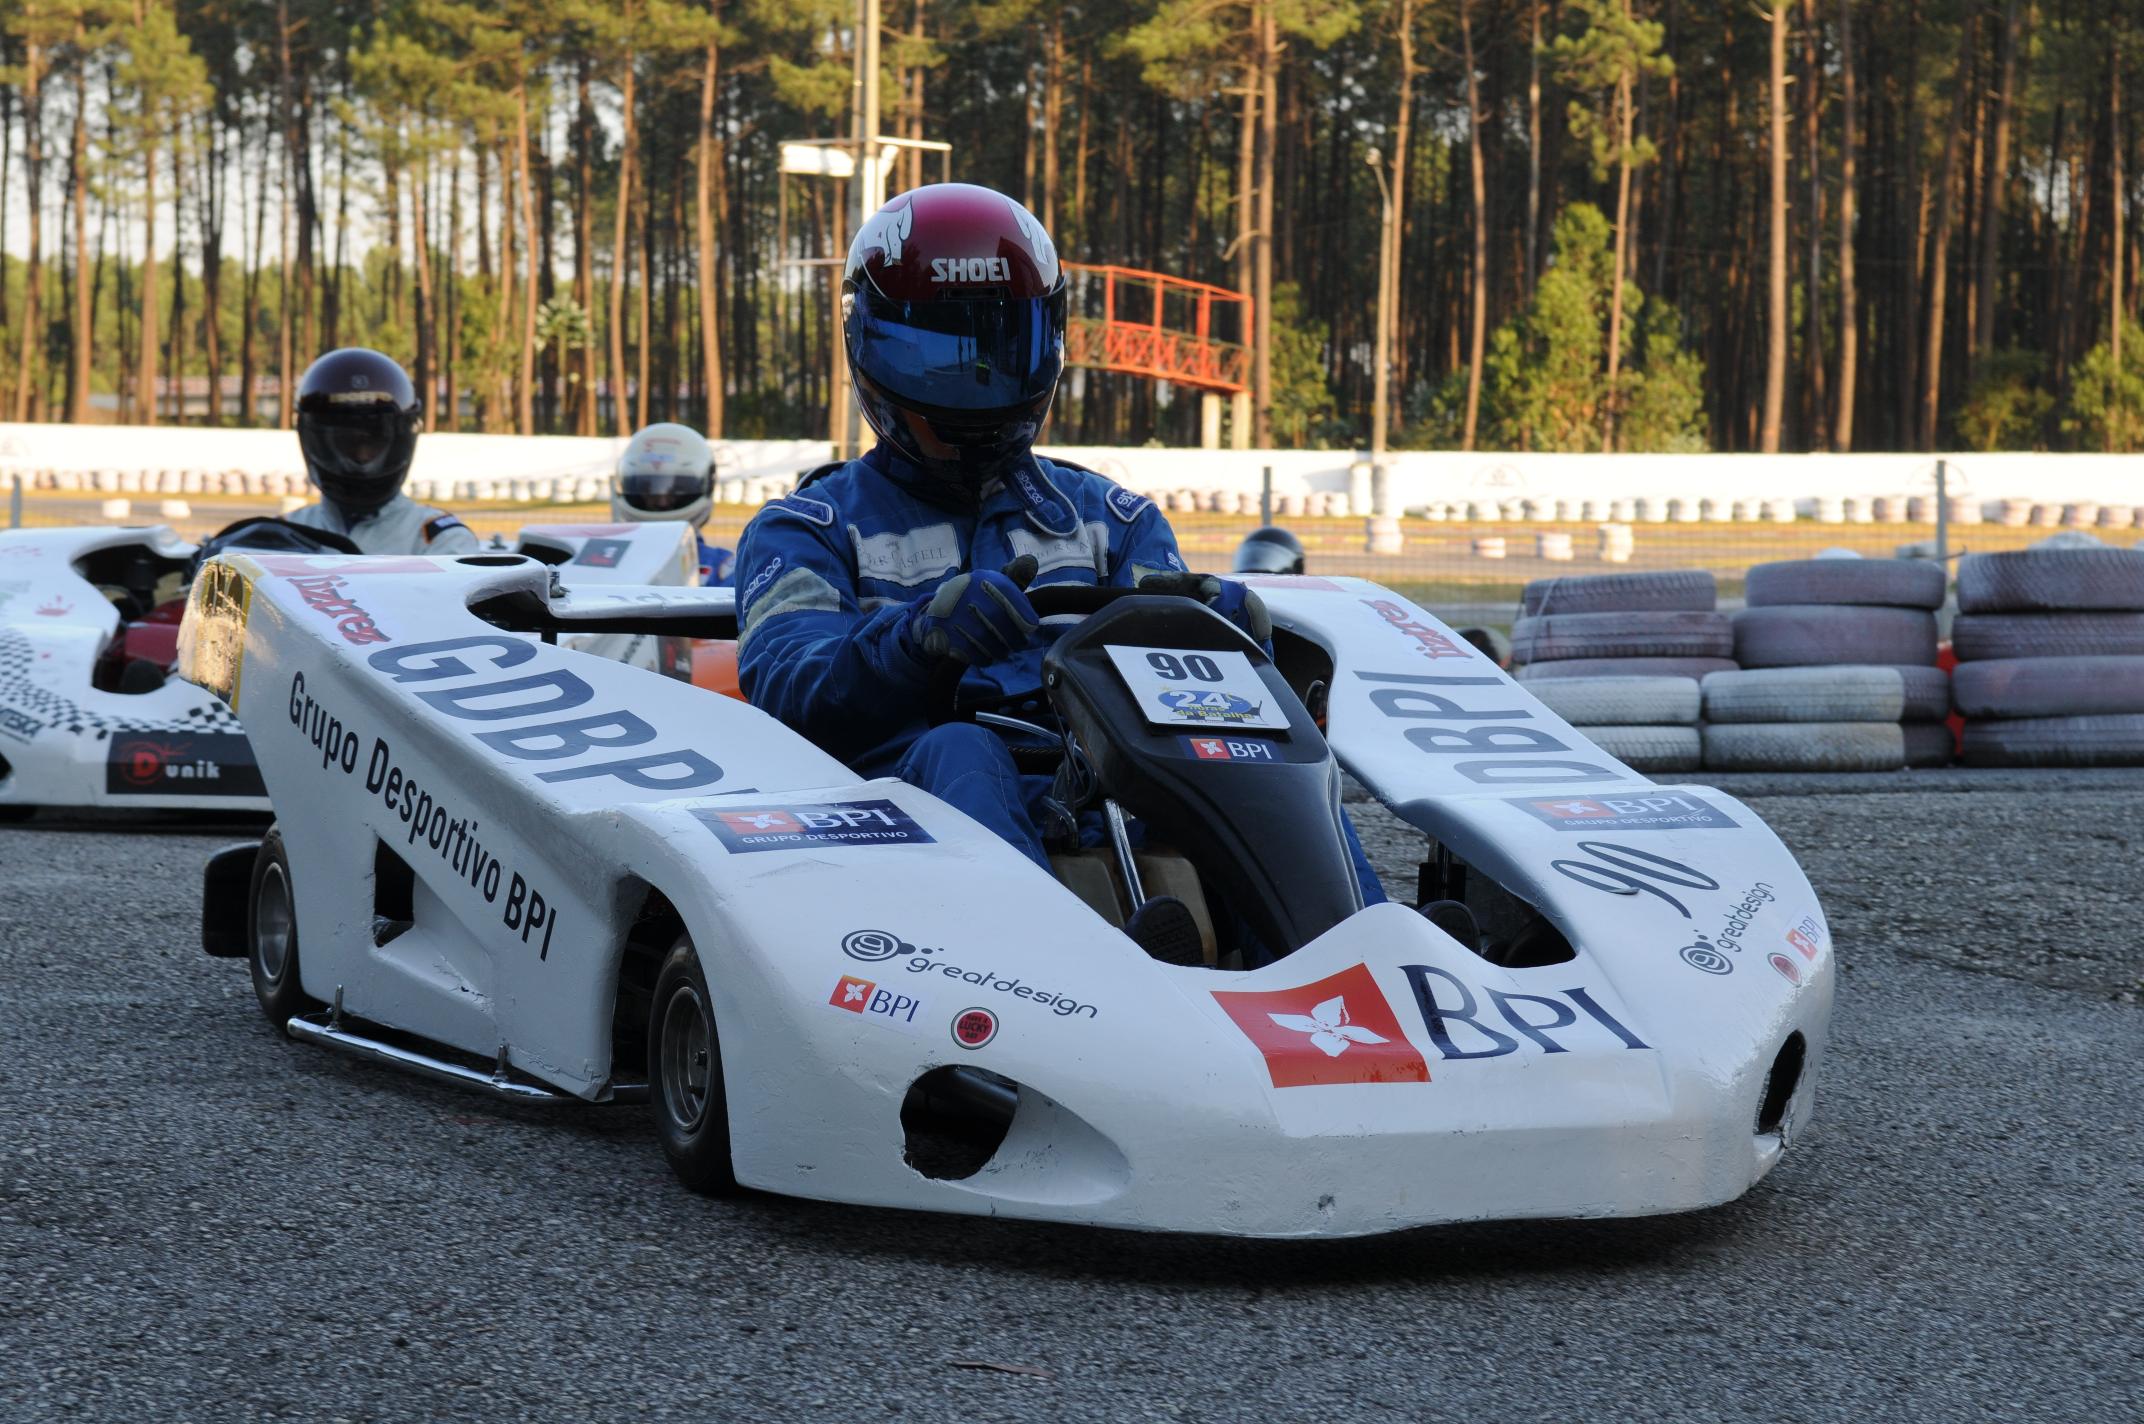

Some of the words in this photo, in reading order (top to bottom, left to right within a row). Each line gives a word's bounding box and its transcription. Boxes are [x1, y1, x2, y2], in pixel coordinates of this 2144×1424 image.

[931, 257, 1011, 282] SHOEI
[1146, 652, 1224, 682] 90
[1170, 691, 1231, 710] 24
[367, 636, 760, 797] GDBP
[1226, 742, 1272, 759] BPI
[289, 670, 359, 774] Grupo
[365, 737, 500, 904] Desportivo
[503, 871, 557, 962] BPI
[794, 809, 897, 829] BPI
[1604, 796, 1699, 815] BPI
[1564, 818, 1617, 826] GRUPO
[1623, 815, 1713, 825] DESPORTIVO
[742, 833, 802, 845] GRUPO
[805, 831, 908, 842] DESPORTIVO
[1550, 841, 1720, 919] 90
[1716, 882, 1776, 953] greatdesign
[1798, 916, 1824, 944] BPI
[905, 957, 1098, 1019] greatdesign
[869, 990, 920, 1023] BPI
[1398, 964, 1655, 1061] BPI
